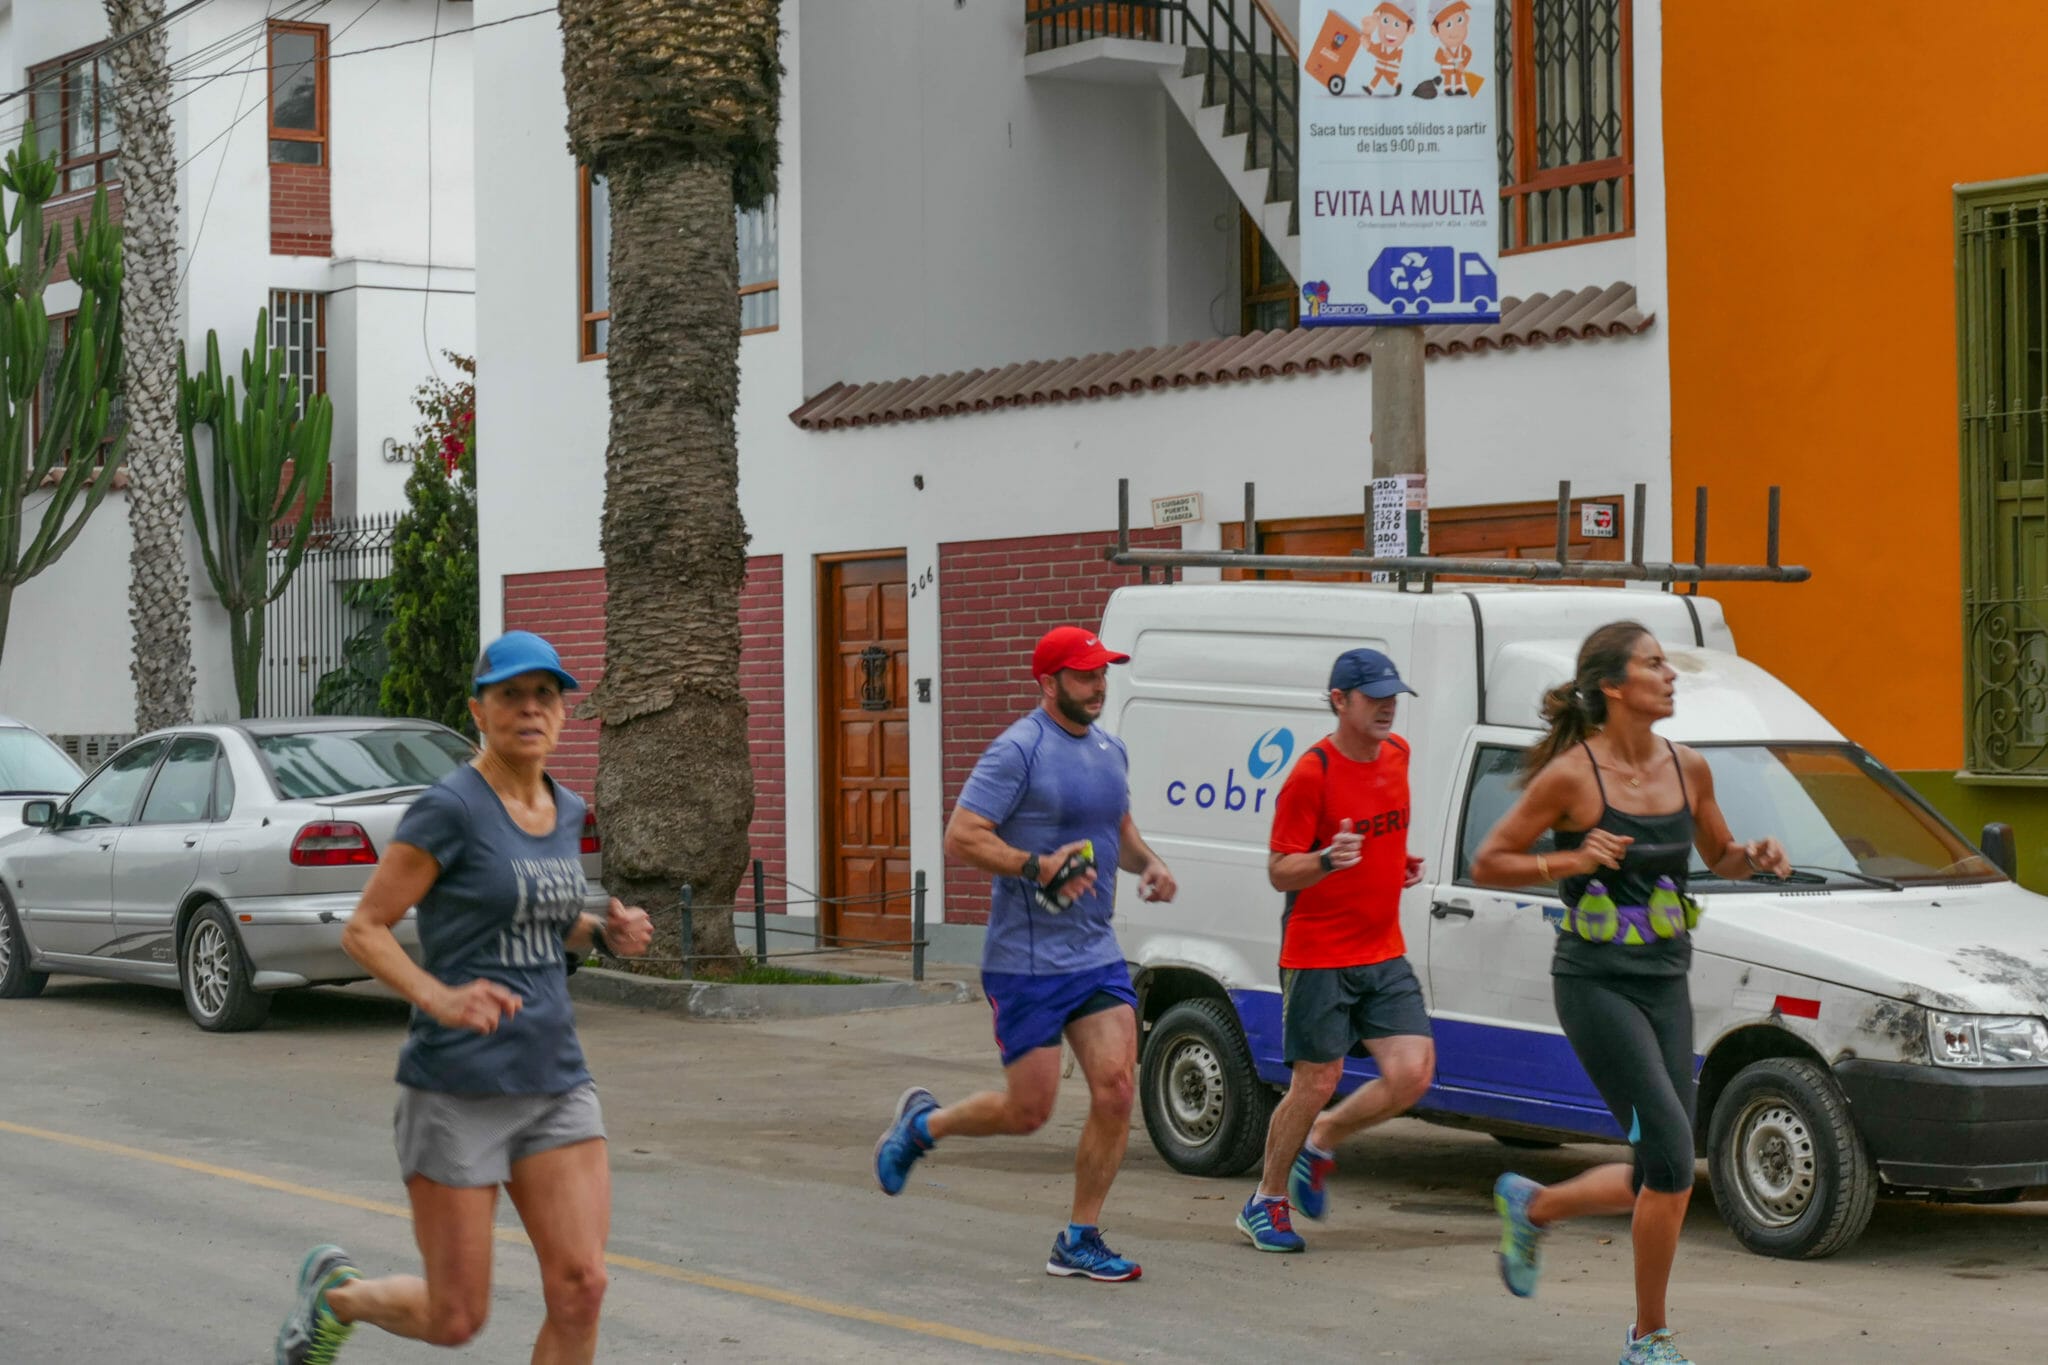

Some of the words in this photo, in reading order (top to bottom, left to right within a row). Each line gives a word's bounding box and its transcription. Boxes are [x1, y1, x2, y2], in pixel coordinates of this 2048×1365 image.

[1309, 123, 1336, 137] Saca
[1339, 122, 1356, 136] tus
[1358, 122, 1404, 136] residuos
[1406, 121, 1446, 136] sólidos
[1447, 125, 1455, 135] a
[1456, 121, 1487, 138] partir
[1357, 139, 1370, 153] de
[1372, 139, 1388, 153] las
[1390, 138, 1415, 153] 9:00
[1417, 141, 1440, 155] p.m.
[1314, 190, 1374, 217] EVITA
[1380, 190, 1405, 217] LA
[1411, 188, 1485, 216] MULTA
[1164, 505, 1189, 515] PUERTA
[911, 566, 933, 598] 206
[1167, 768, 1278, 813] cobr
